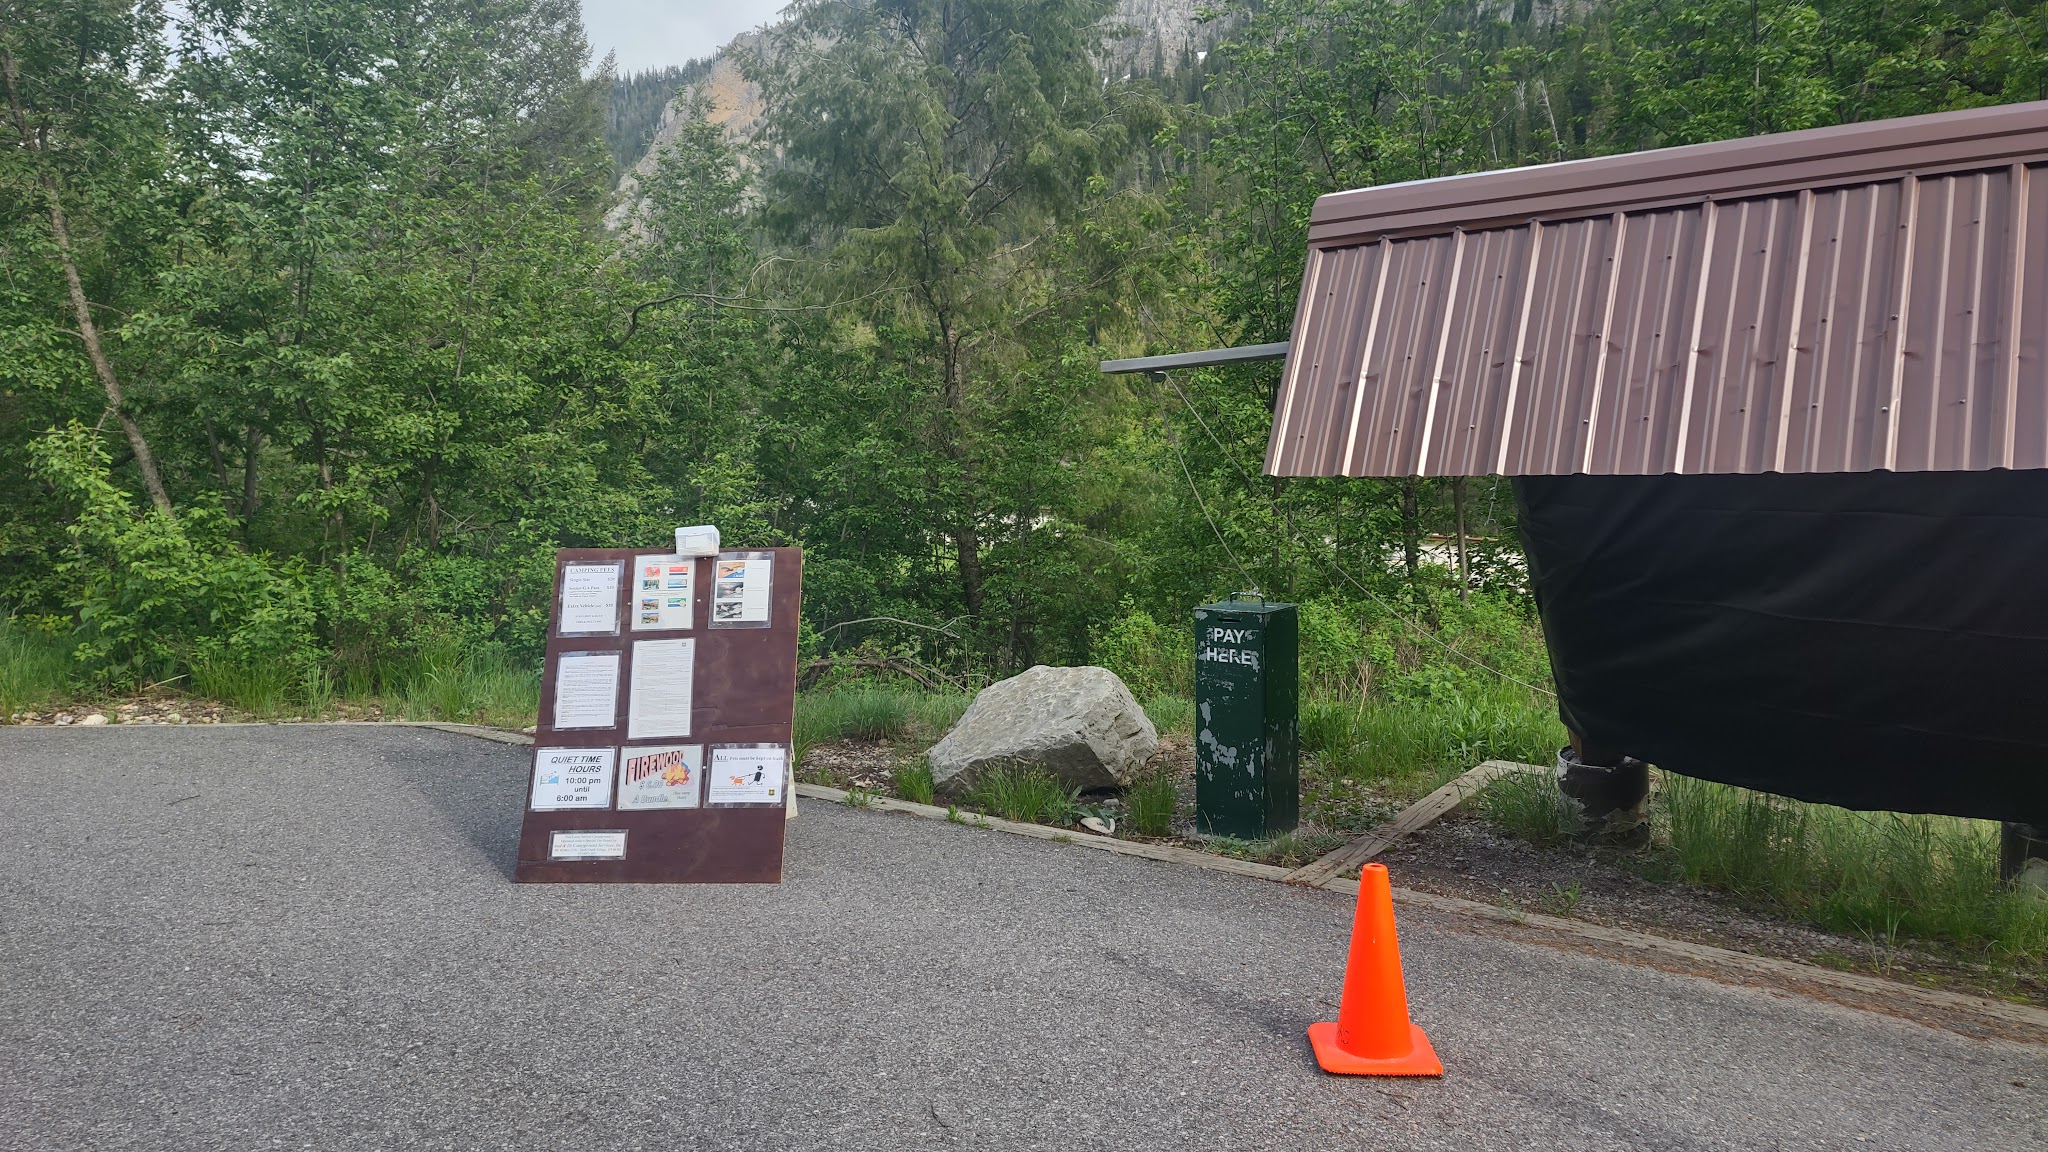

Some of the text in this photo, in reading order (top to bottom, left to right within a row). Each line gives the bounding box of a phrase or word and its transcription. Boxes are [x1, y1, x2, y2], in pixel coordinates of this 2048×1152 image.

[1213, 628, 1244, 644] PAY
[1206, 647, 1252, 665] HERE
[550, 755, 603, 764] QUIET TIME
[568, 765, 602, 773] HOURS
[632, 794, 668, 804] A Bundle
